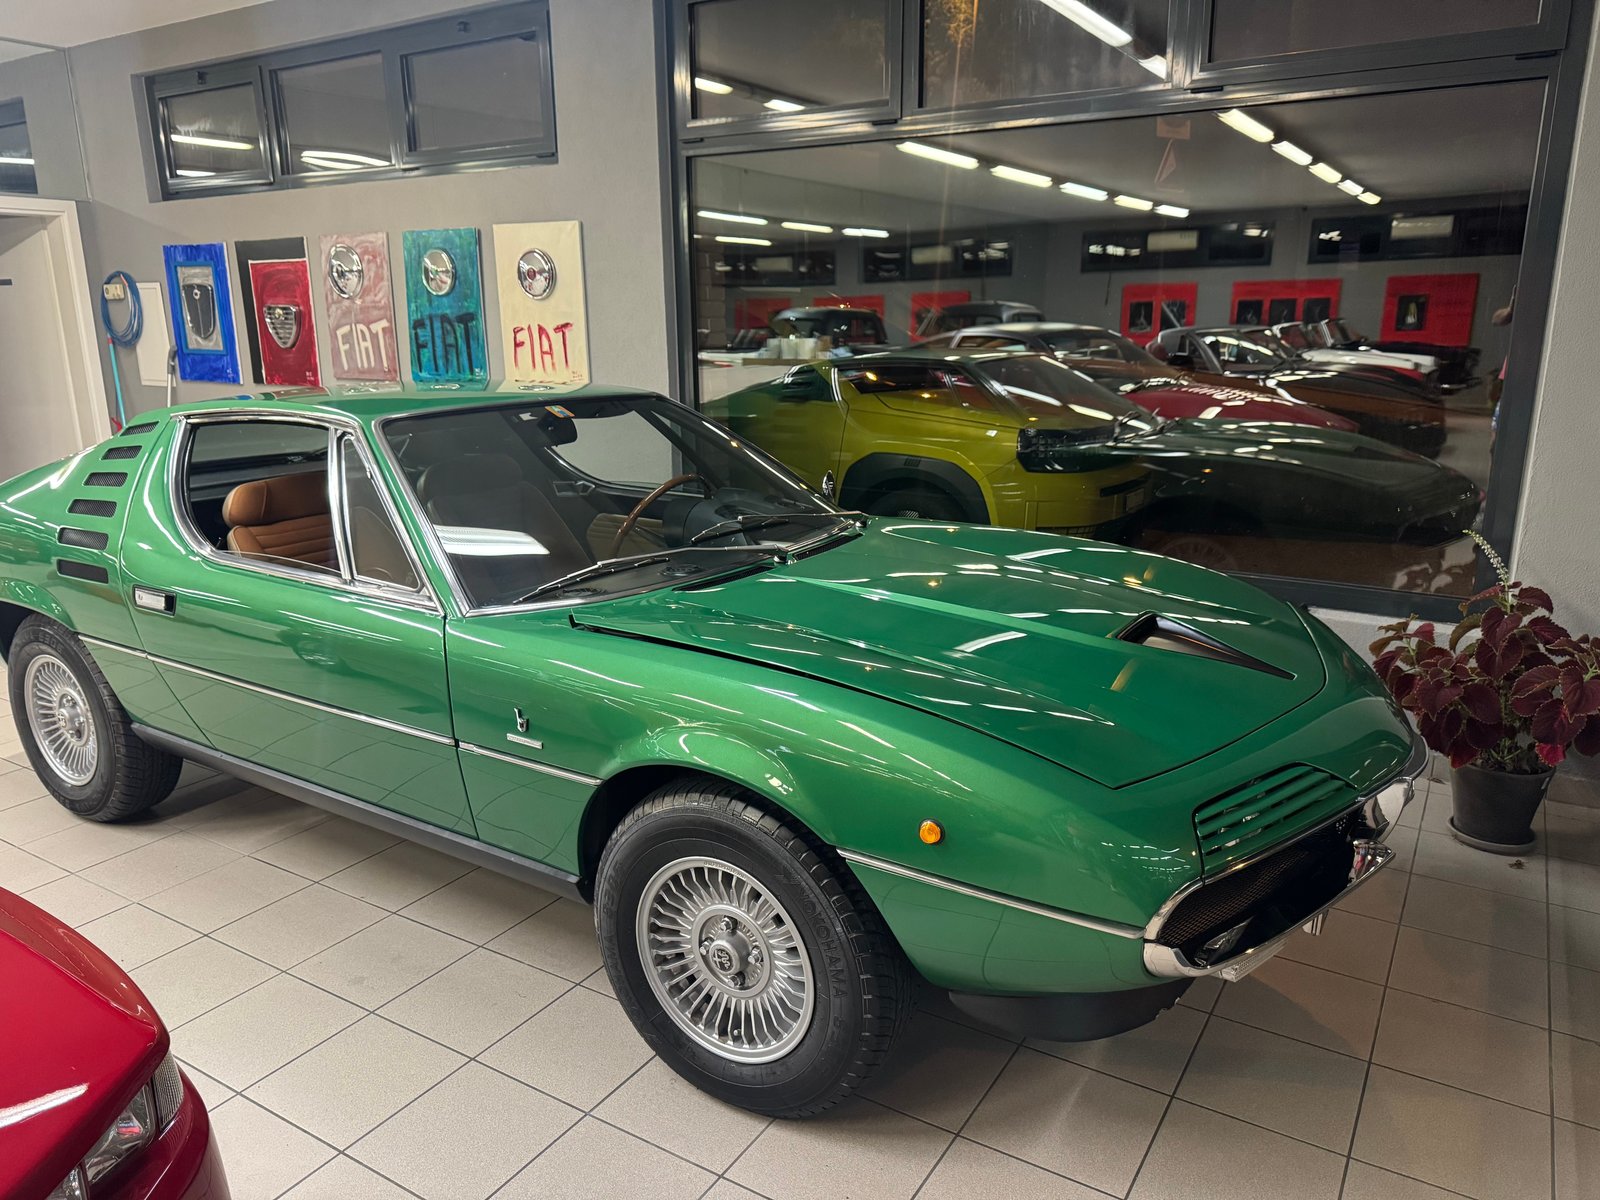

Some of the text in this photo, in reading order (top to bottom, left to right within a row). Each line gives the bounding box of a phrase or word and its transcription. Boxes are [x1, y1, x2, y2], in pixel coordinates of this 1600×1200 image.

[336, 318, 390, 371] FIAT
[412, 312, 475, 375] FIAT
[512, 321, 573, 374] FIAT
[801, 886, 849, 999] YOKOHAMA
